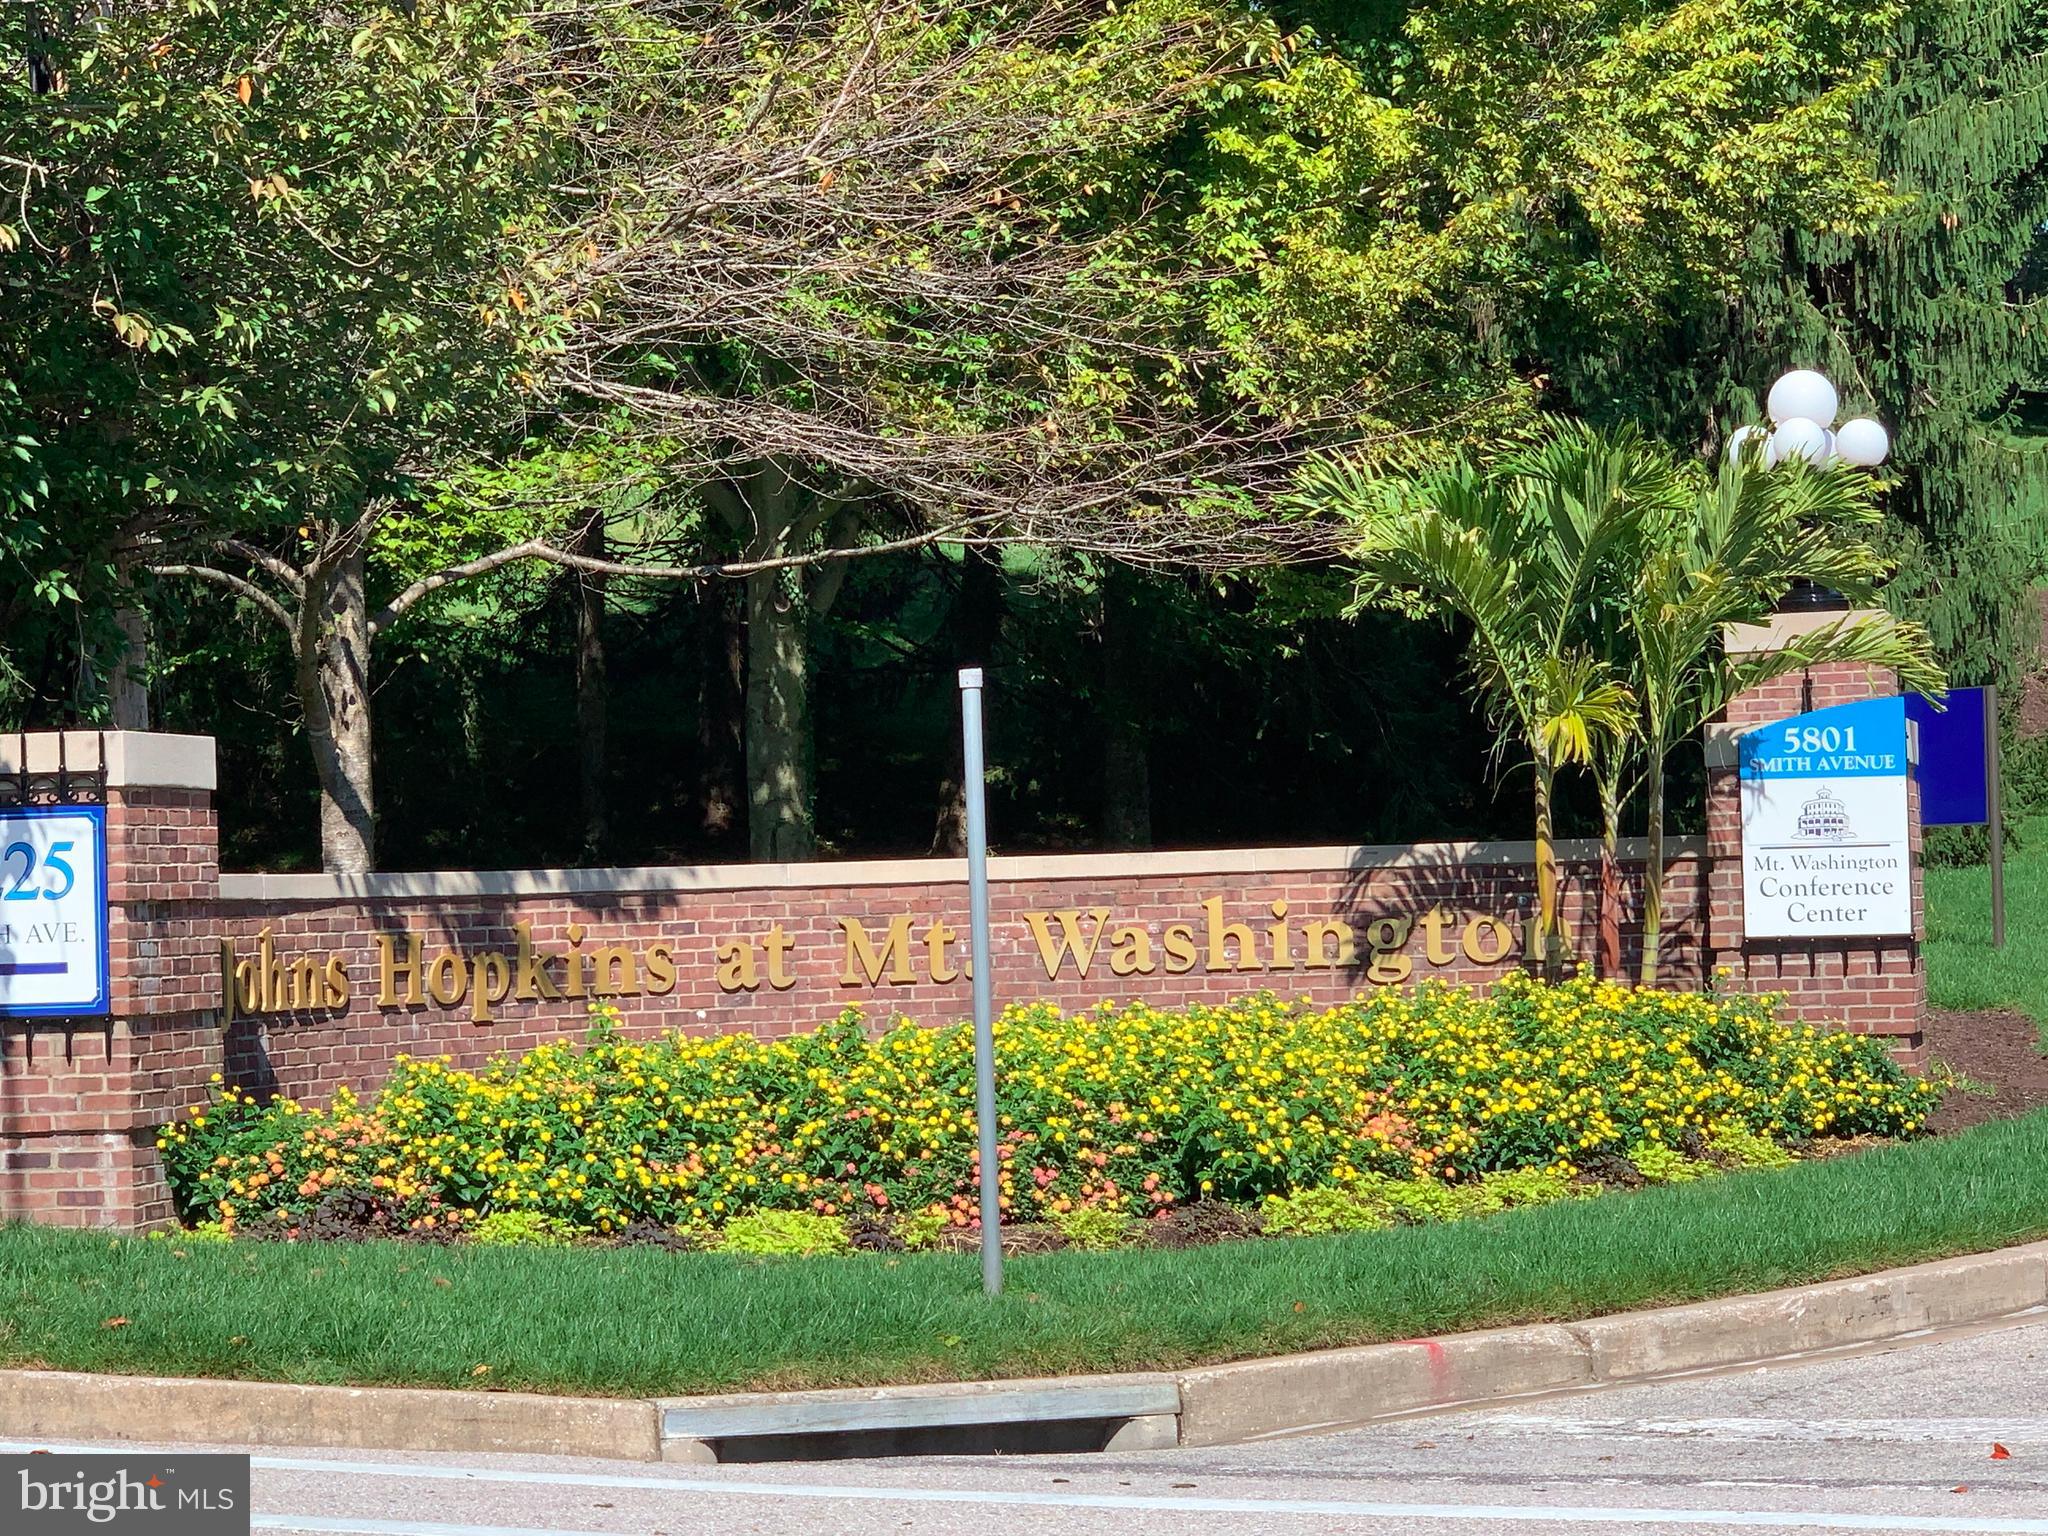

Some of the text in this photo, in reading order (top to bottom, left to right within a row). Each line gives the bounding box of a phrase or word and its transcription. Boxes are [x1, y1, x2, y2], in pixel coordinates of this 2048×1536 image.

[1783, 726, 1857, 754] 5801
[1750, 754, 1896, 773] SMITH AVENUE
[0, 841, 75, 901] 25
[1753, 854, 1898, 873] Mt. Washington
[1759, 876, 1894, 898] Conference
[1787, 902, 1867, 923] Center
[26, 922, 85, 944] AVE.
[221, 926, 349, 1033] Johns
[376, 919, 677, 1024] Hopkins
[717, 923, 796, 990] at
[1023, 895, 1577, 983] Washington
